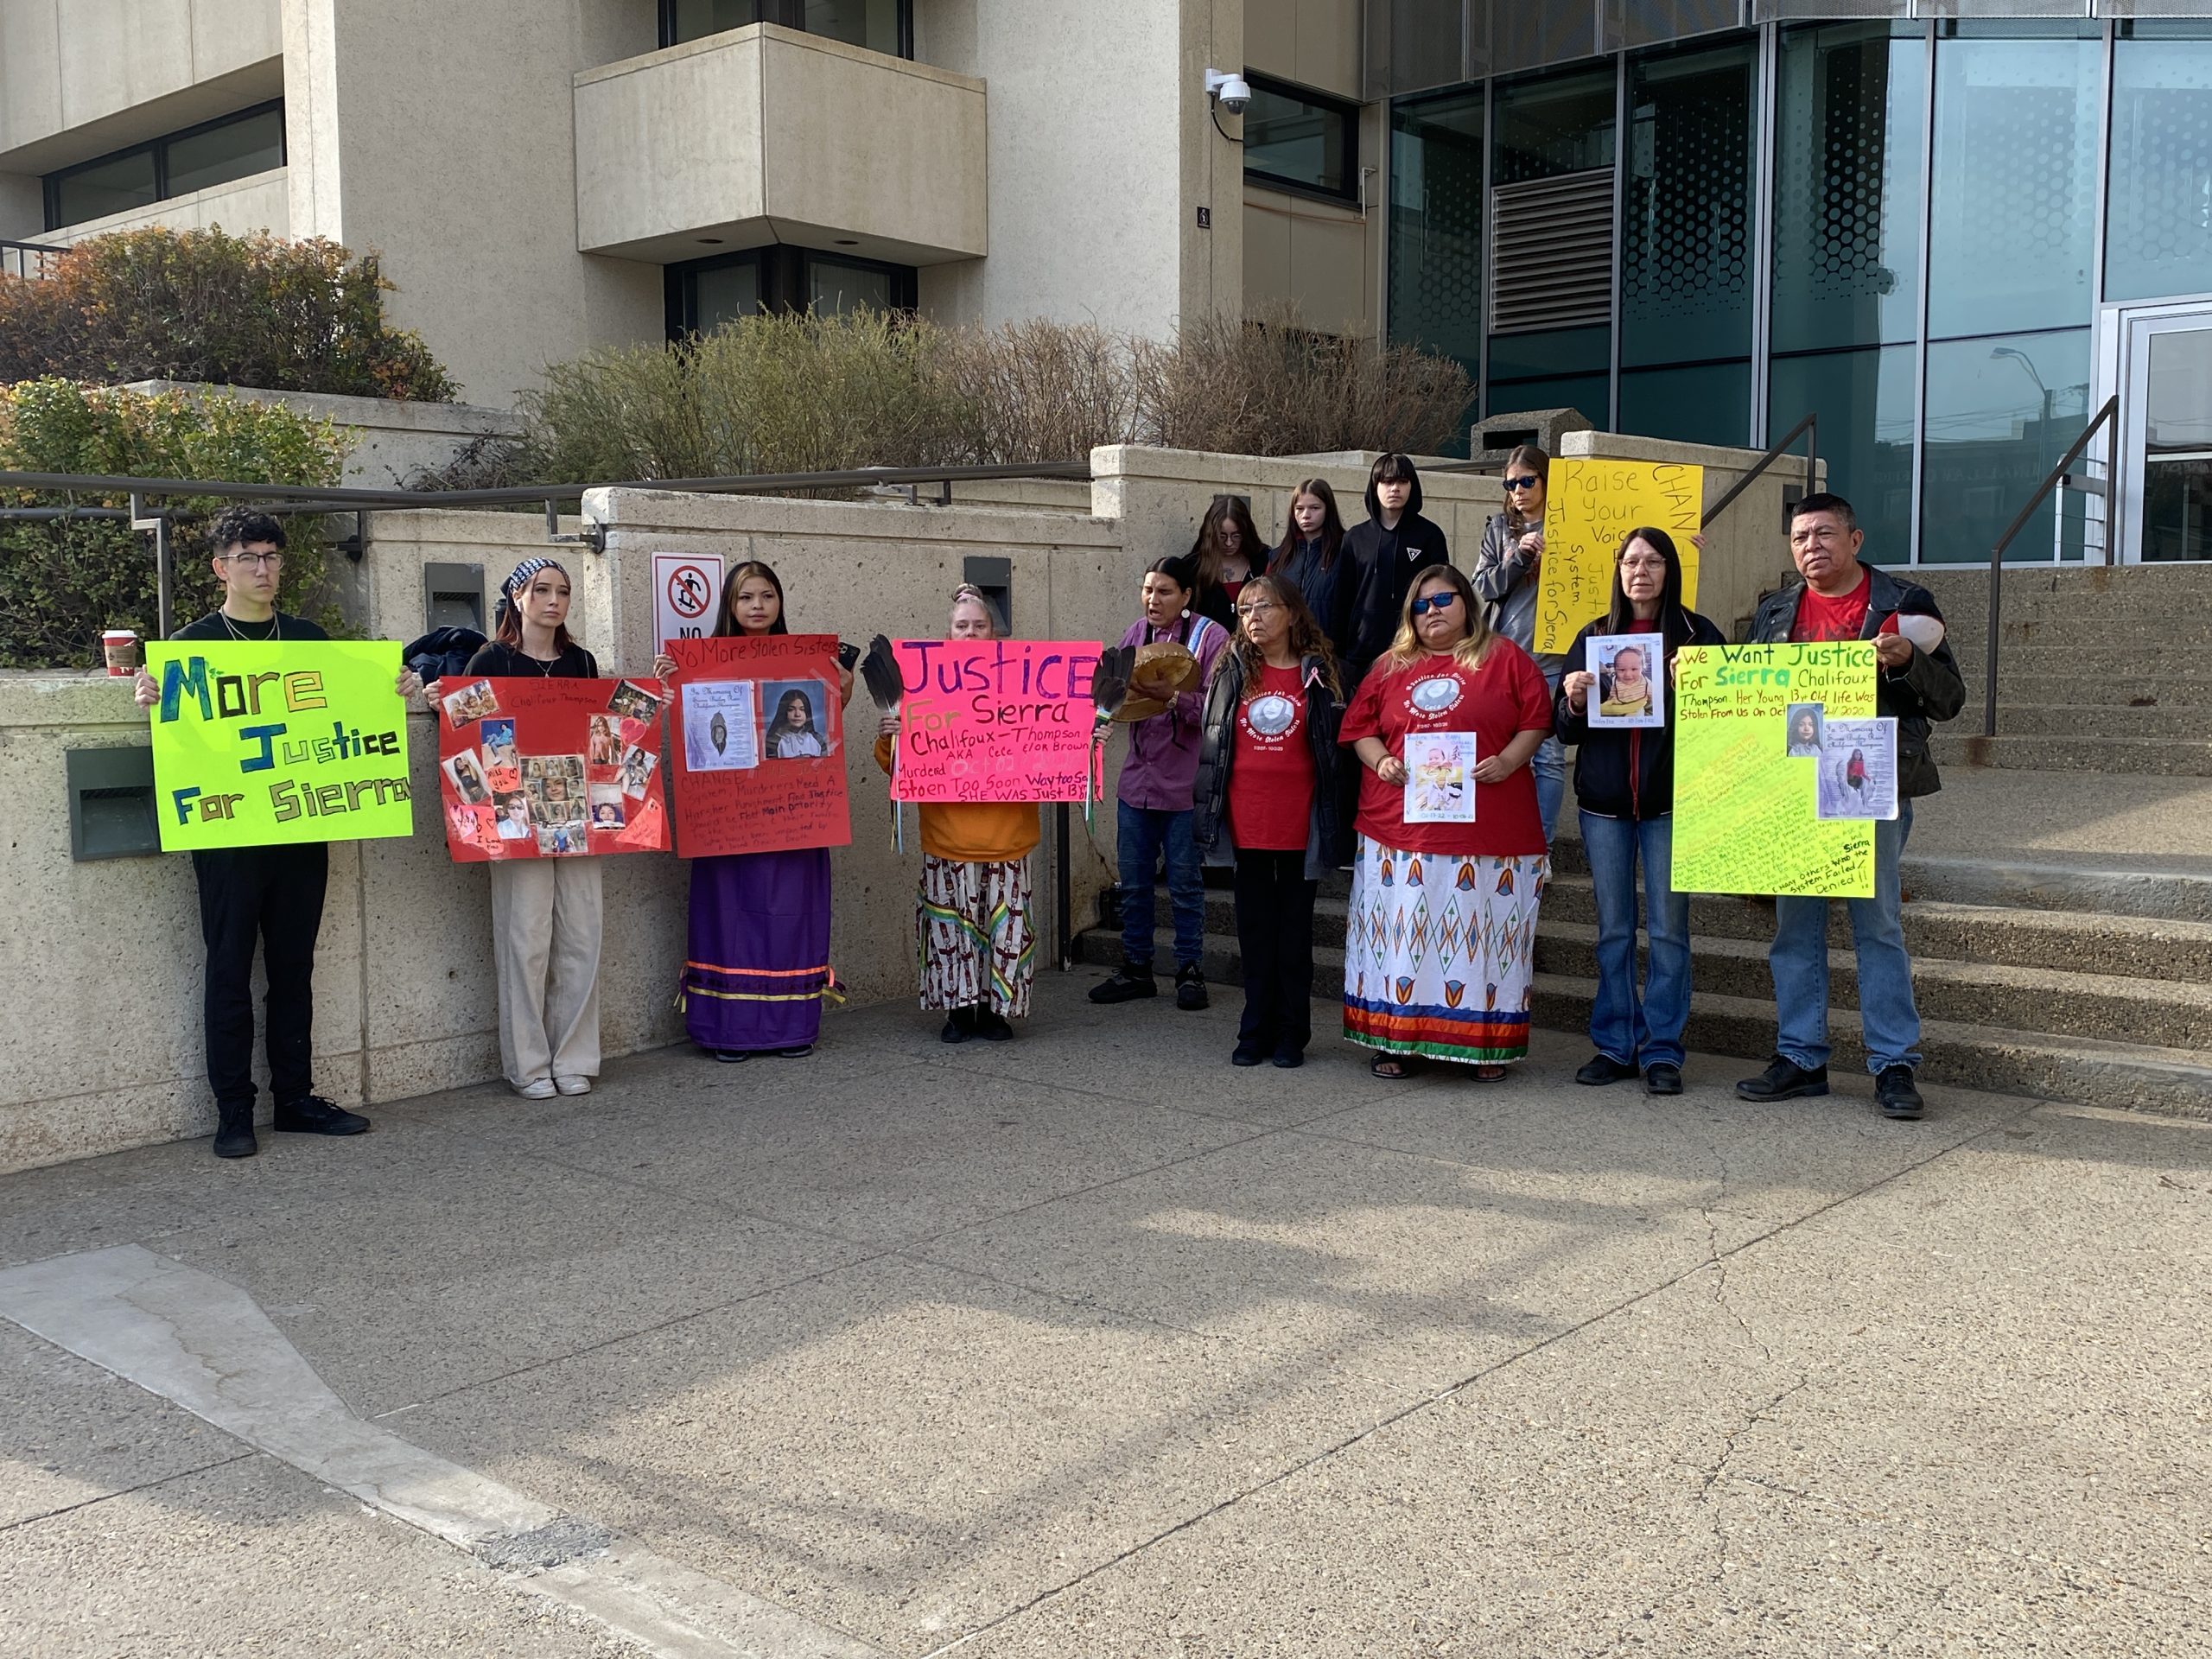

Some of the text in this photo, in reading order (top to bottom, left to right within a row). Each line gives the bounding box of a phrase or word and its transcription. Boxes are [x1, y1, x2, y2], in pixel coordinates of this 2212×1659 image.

[1565, 461, 1640, 493] Raise
[1547, 498, 1566, 576] Justice
[1592, 526, 1626, 543] Voic
[666, 640, 698, 668] No
[702, 638, 747, 664] More
[751, 638, 788, 658] Stolen
[1682, 642, 1874, 667] We Want Justice
[160, 657, 327, 722] More
[1681, 671, 1708, 690] For
[1715, 666, 1789, 688] Sierra
[1737, 690, 1752, 702] Her
[1757, 690, 1784, 706] Young
[907, 694, 1070, 733] For Sierra
[1680, 709, 1708, 721] Stolen
[1711, 709, 1733, 719] From
[1770, 707, 1785, 716] Oct
[238, 721, 400, 772] Justice
[946, 748, 973, 761] AKA
[681, 772, 745, 792] CHANGE
[986, 774, 1020, 790] Soon
[1026, 772, 1054, 790] Way
[172, 777, 411, 825] For Sierra
[958, 791, 988, 802] SHE
[995, 789, 1029, 801] WAS
[1033, 786, 1064, 800] Just
[1068, 785, 1077, 797] 13
